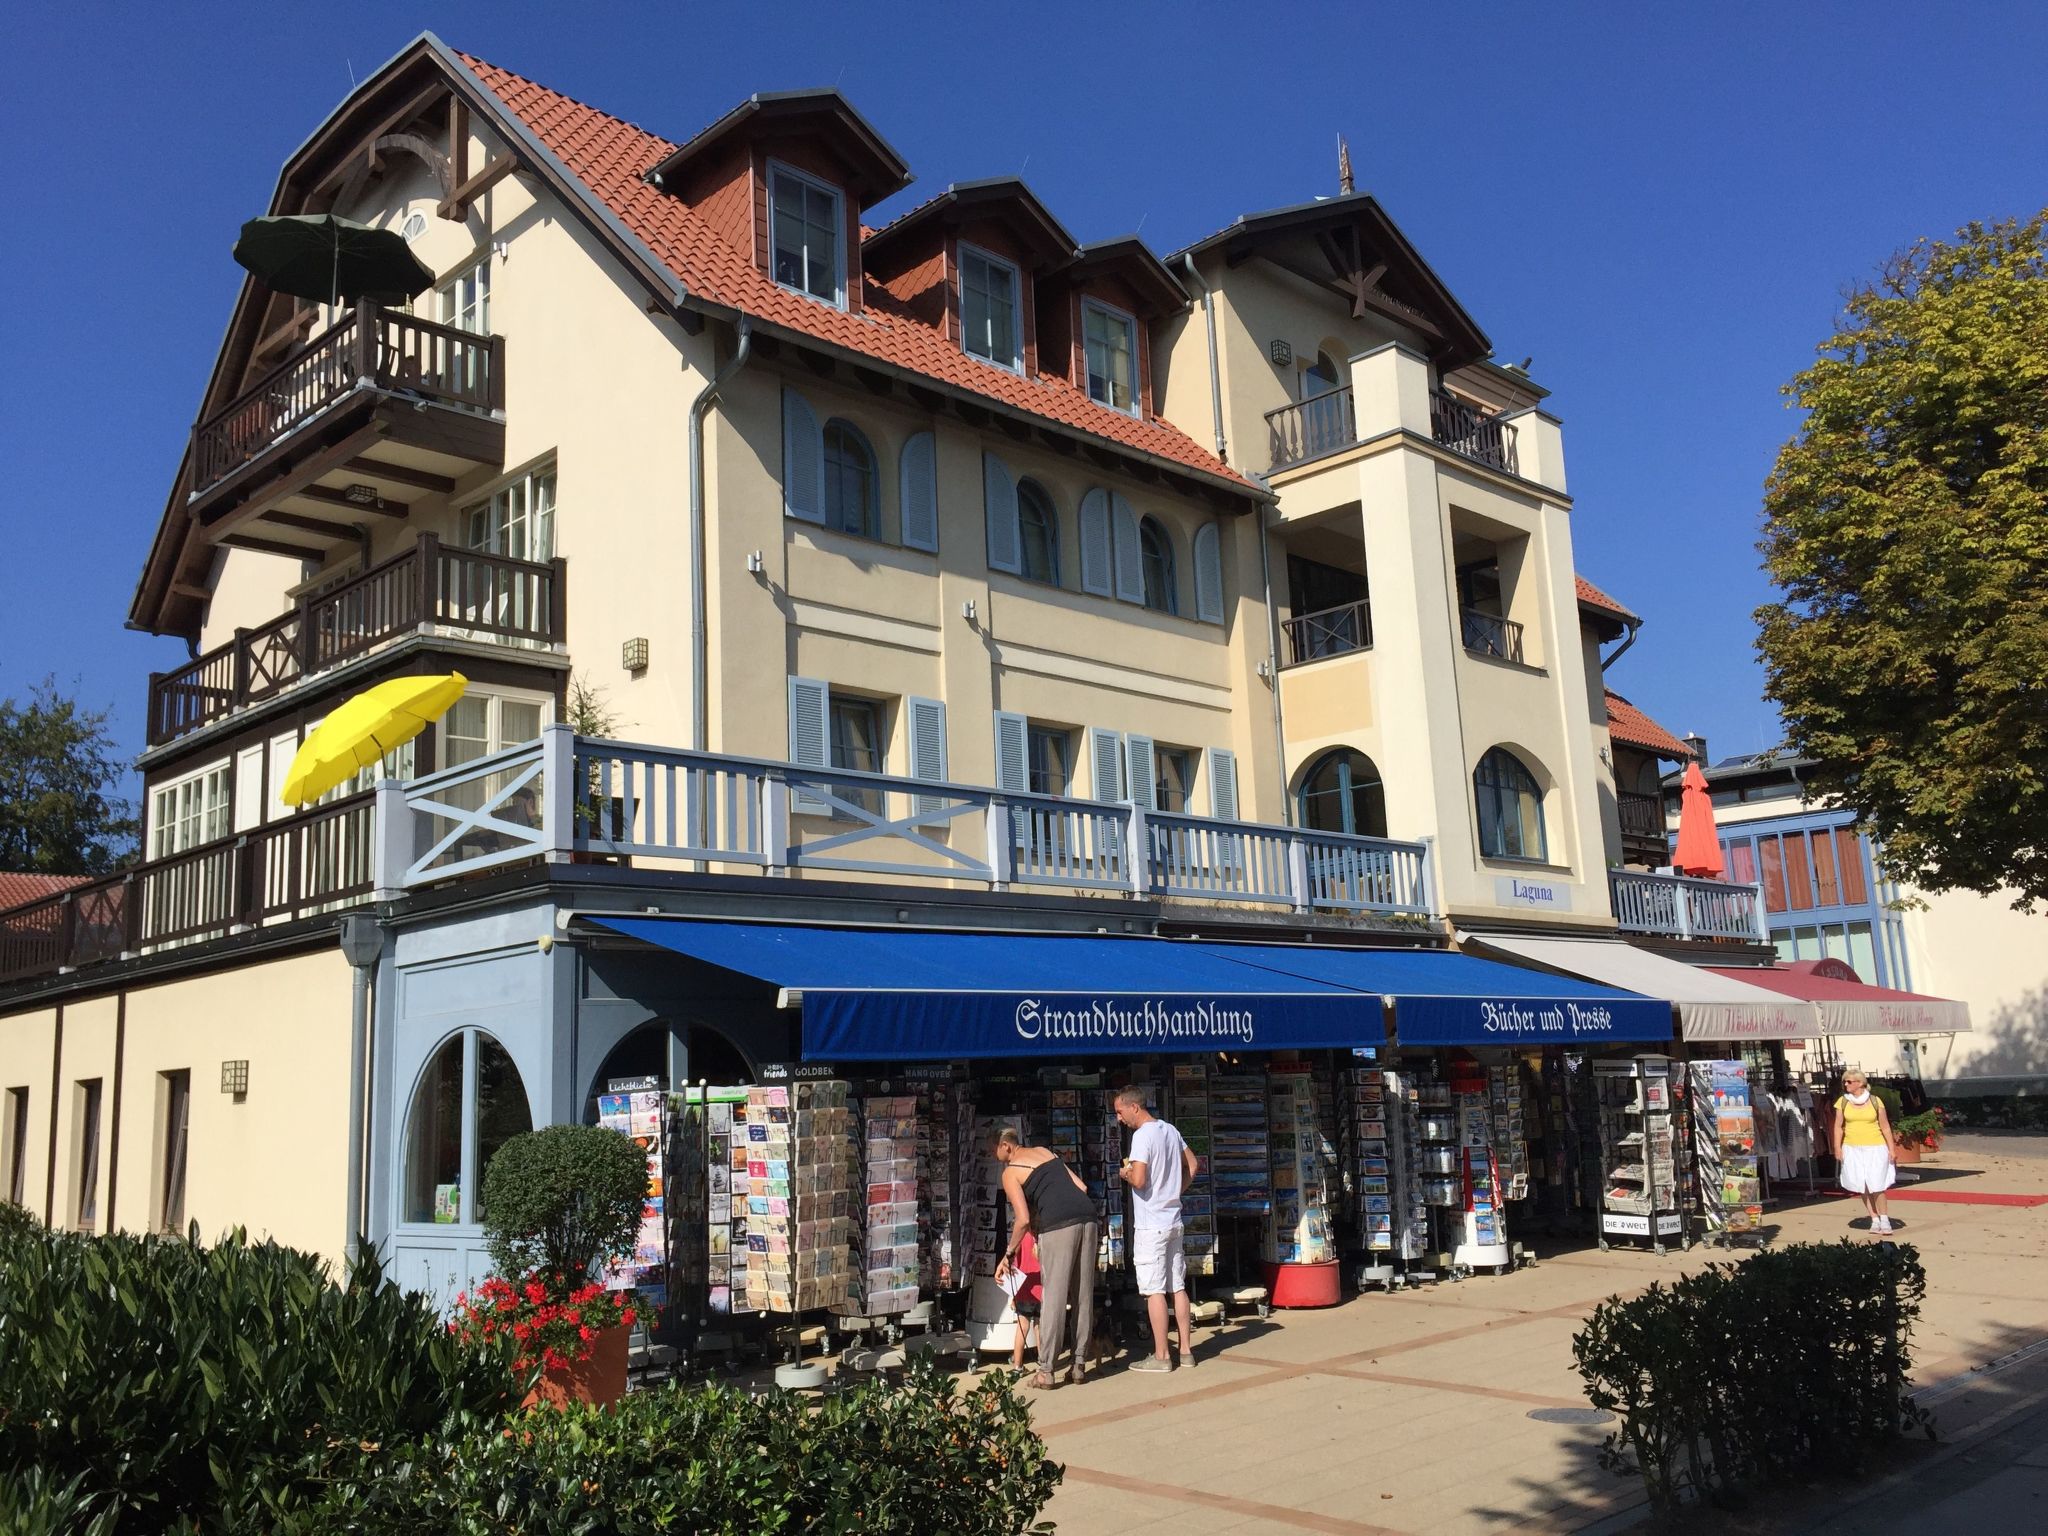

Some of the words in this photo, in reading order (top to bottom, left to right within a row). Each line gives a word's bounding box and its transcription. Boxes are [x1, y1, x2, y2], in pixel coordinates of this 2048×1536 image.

[1512, 880, 1553, 904] Laguna
[1015, 999, 1254, 1044] Strandbuchhandlung
[1481, 1002, 1536, 1038] Bücher
[1540, 1003, 1564, 1031] und
[1567, 1003, 1612, 1037] Presse
[763, 1067, 788, 1079] friends
[795, 1066, 834, 1077] GOLDBEK
[1605, 1220, 1617, 1228] DIE
